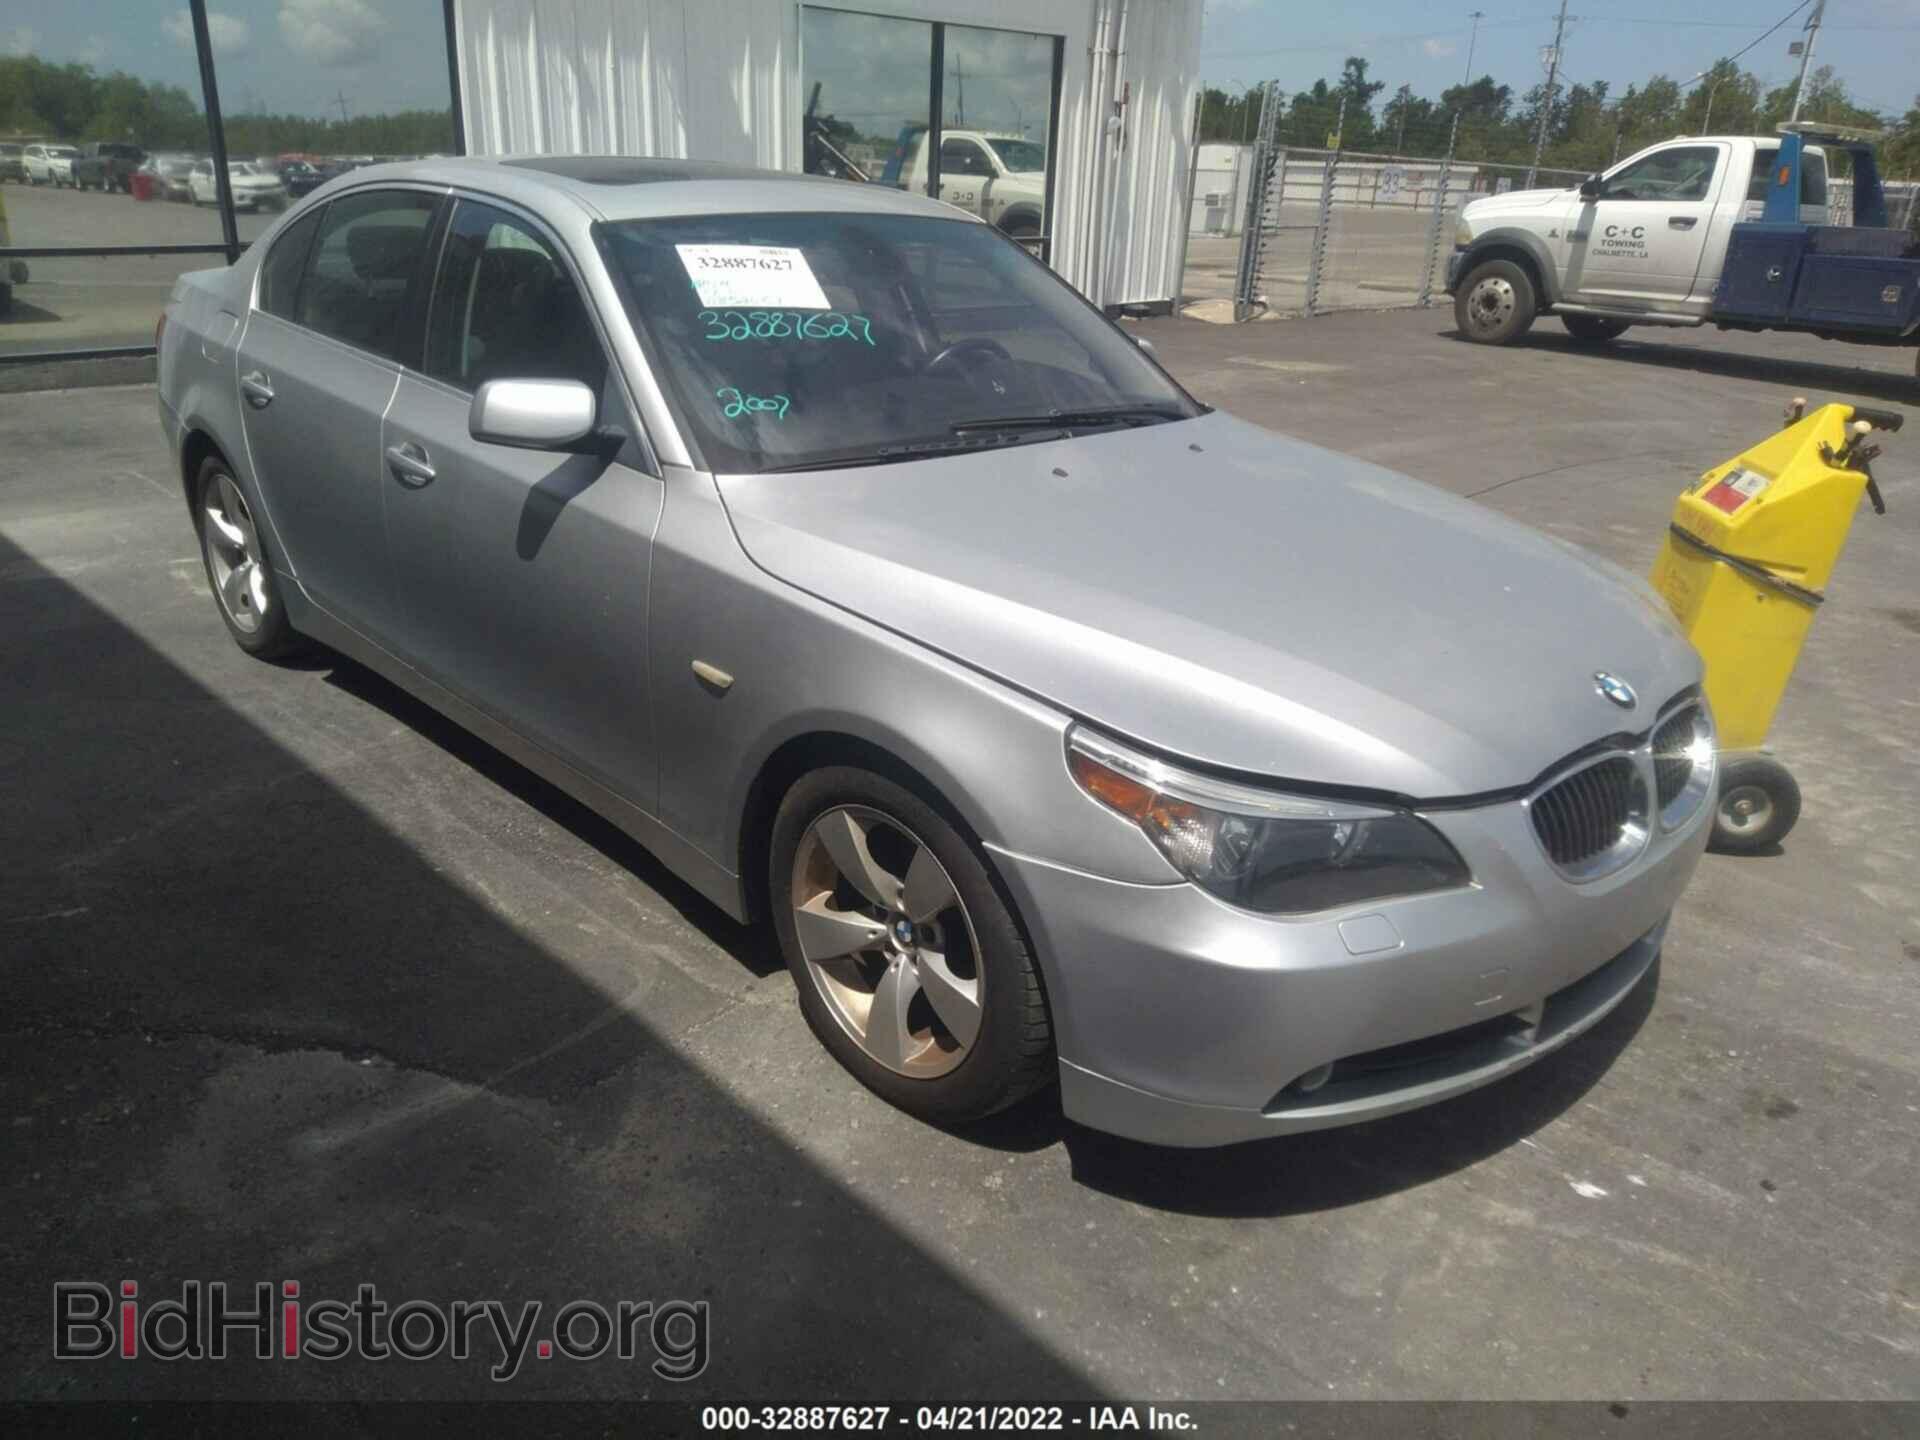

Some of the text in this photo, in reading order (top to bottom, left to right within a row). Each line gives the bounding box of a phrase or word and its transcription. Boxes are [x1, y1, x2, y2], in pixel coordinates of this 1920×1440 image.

[1601, 239, 1645, 249] TOWING
[697, 256, 793, 271] 32887627
[698, 311, 876, 346] 32887627
[717, 387, 790, 420] 2007
